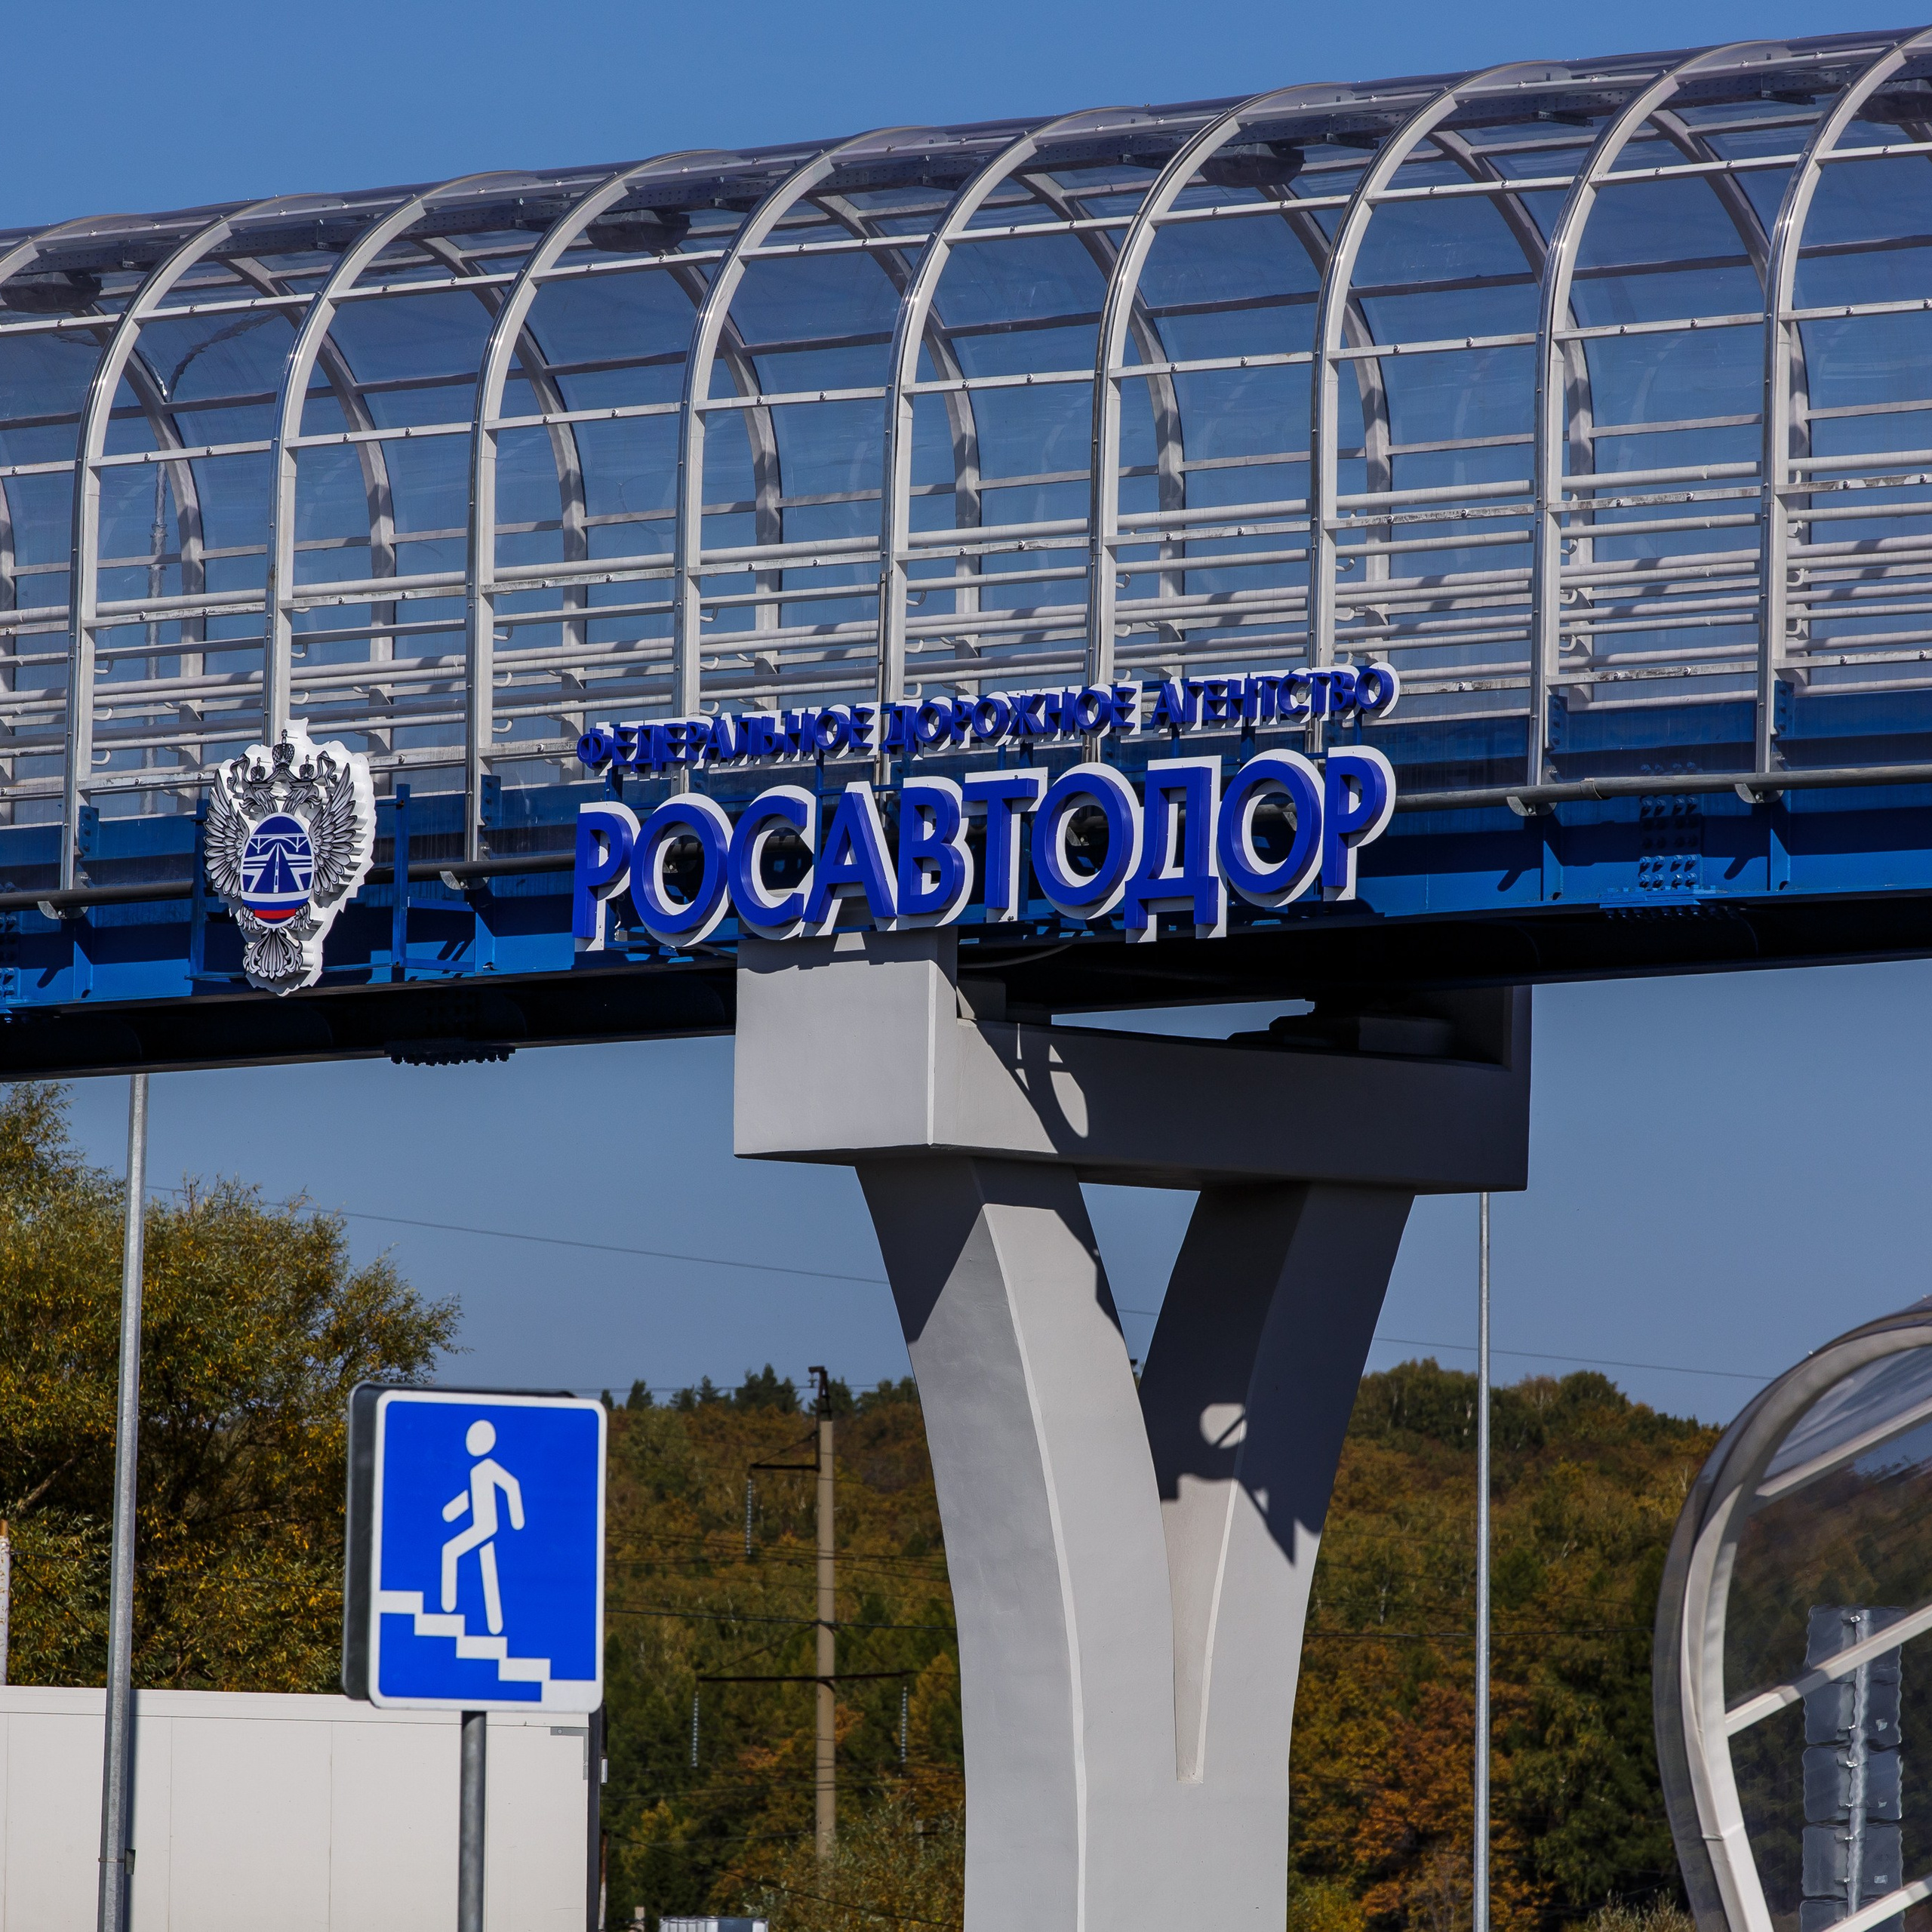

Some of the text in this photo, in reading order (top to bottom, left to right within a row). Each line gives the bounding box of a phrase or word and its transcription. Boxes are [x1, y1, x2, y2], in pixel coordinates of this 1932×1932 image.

[577, 663, 1399, 778] ФЕДЕРАЛЬНОЕ ДОРОЖНОЕ АГЕНТСТВО
[573, 746, 1395, 951] РОСАВТОДОР
